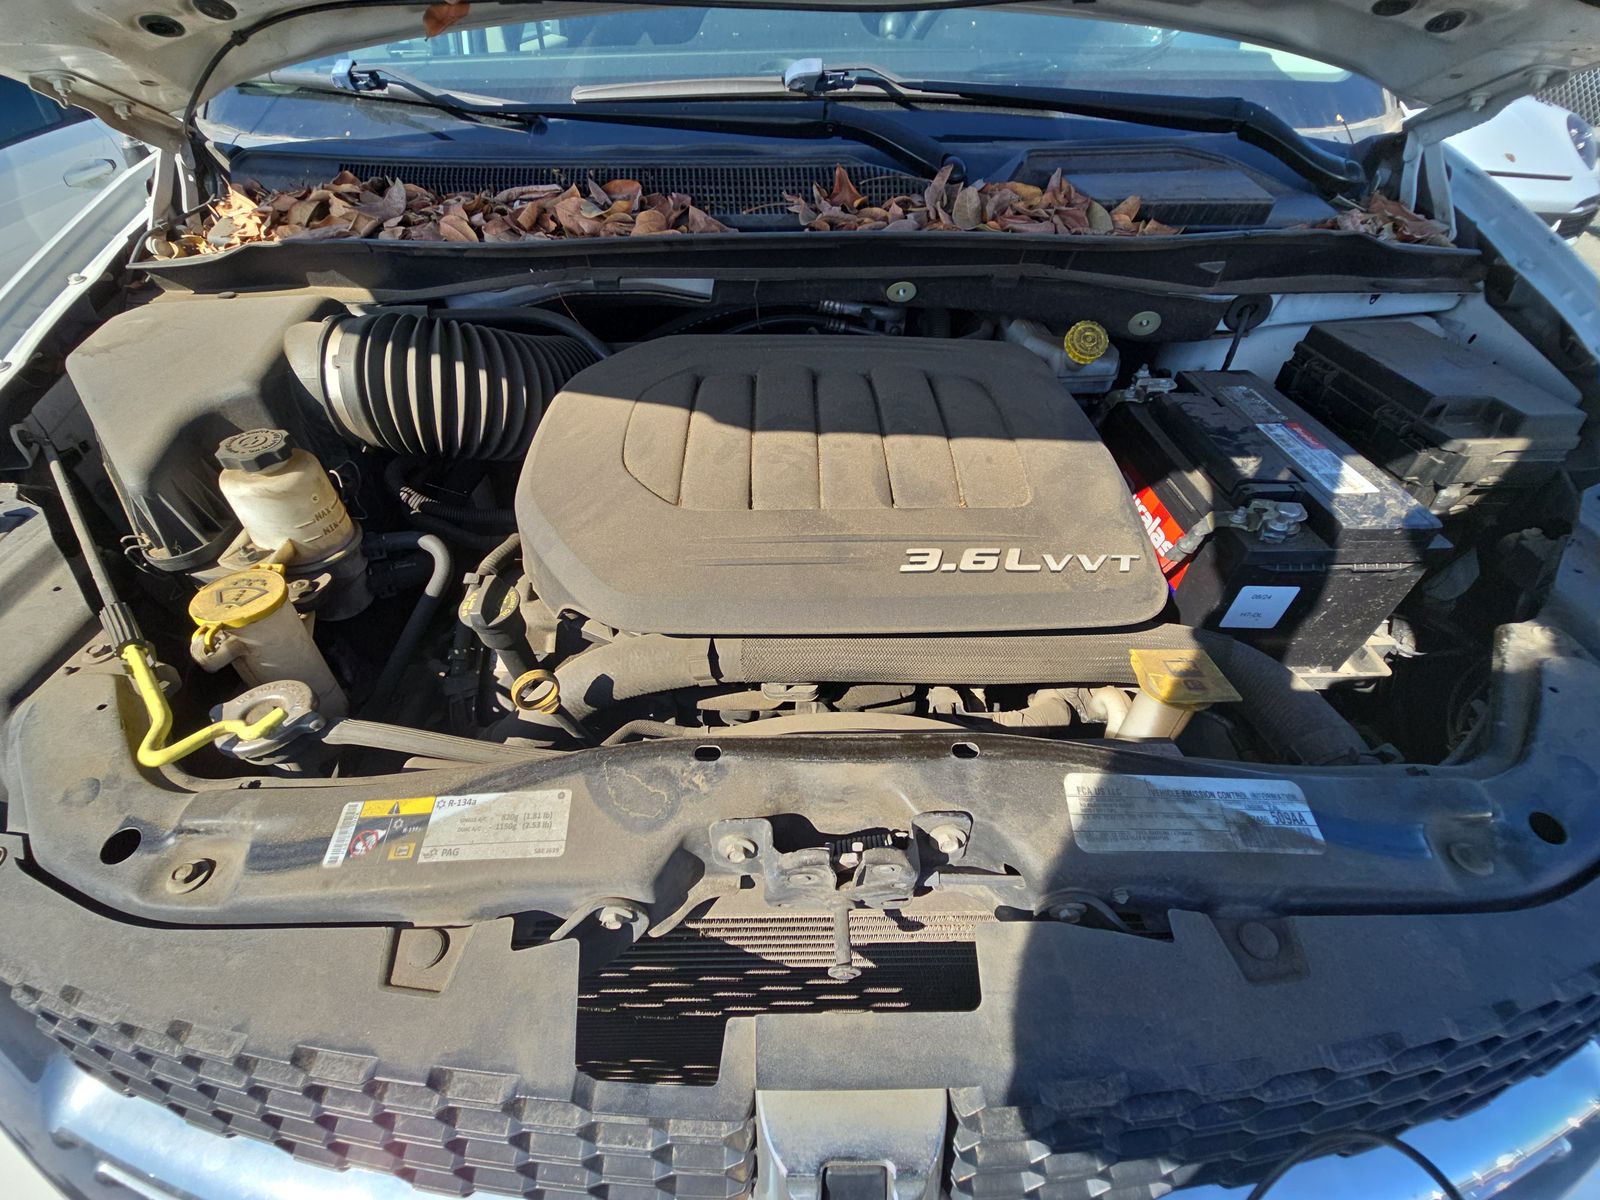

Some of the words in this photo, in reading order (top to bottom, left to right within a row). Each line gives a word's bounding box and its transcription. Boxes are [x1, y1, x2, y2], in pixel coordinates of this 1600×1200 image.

[313, 507, 332, 523] MAX
[322, 522, 340, 537] MIN
[900, 548, 1042, 573] 3.6L
[1042, 554, 1141, 573] VVT
[1217, 791, 1248, 800] CONTROL
[447, 798, 477, 808] R-134a
[1270, 811, 1308, 825] 509AA
[441, 847, 460, 857] PAG
